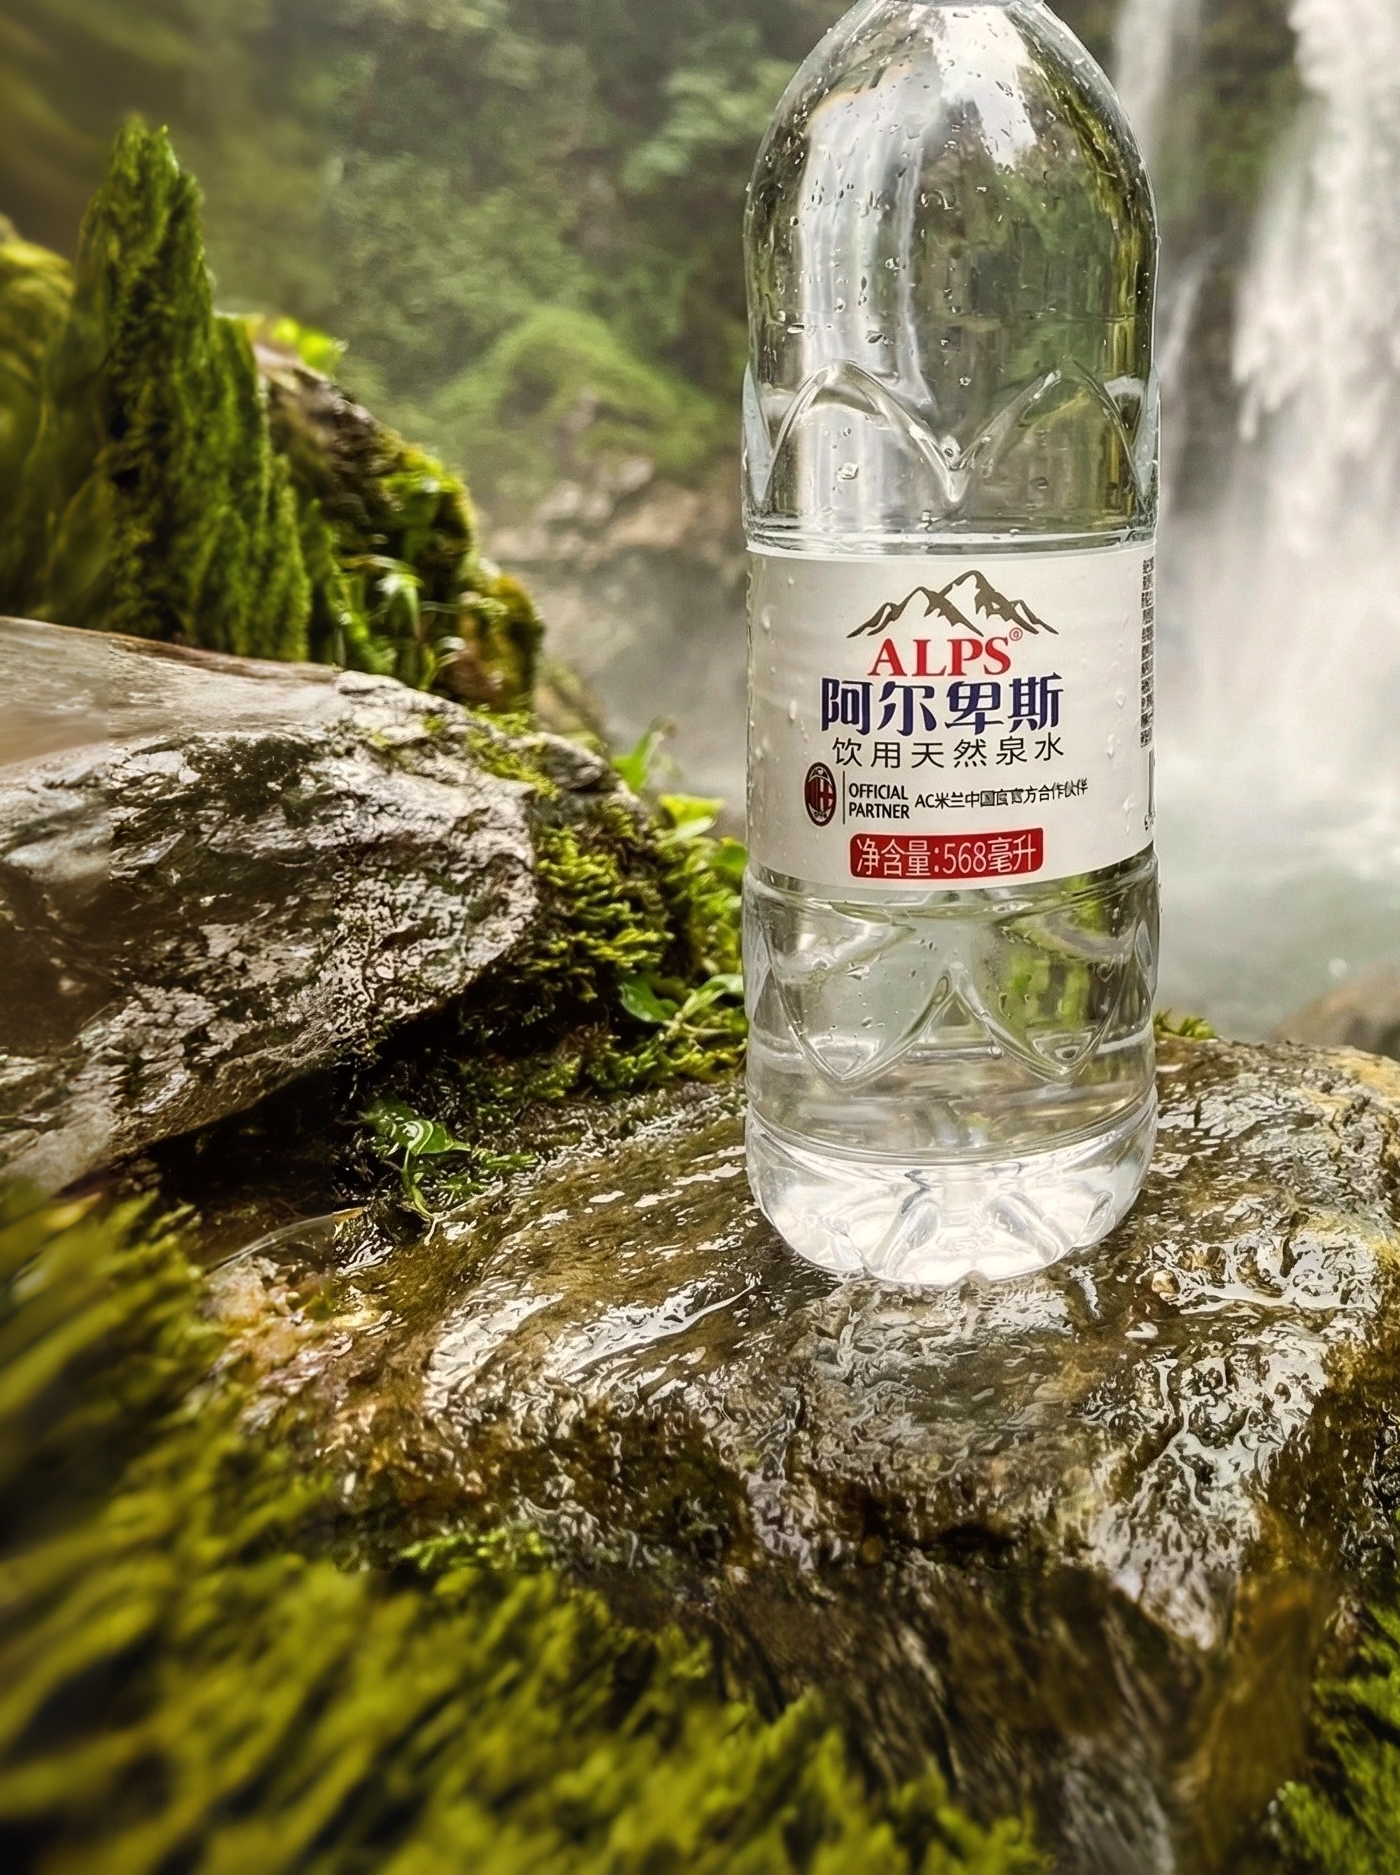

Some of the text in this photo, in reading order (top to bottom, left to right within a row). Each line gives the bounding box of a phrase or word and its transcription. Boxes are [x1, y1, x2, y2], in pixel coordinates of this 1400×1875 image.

[820, 672, 1065, 737] 阿尔卑斯
[832, 731, 1065, 768] 饮用天然泉水
[848, 782, 909, 801] OFFICIAL
[848, 802, 910, 820] PARTNER
